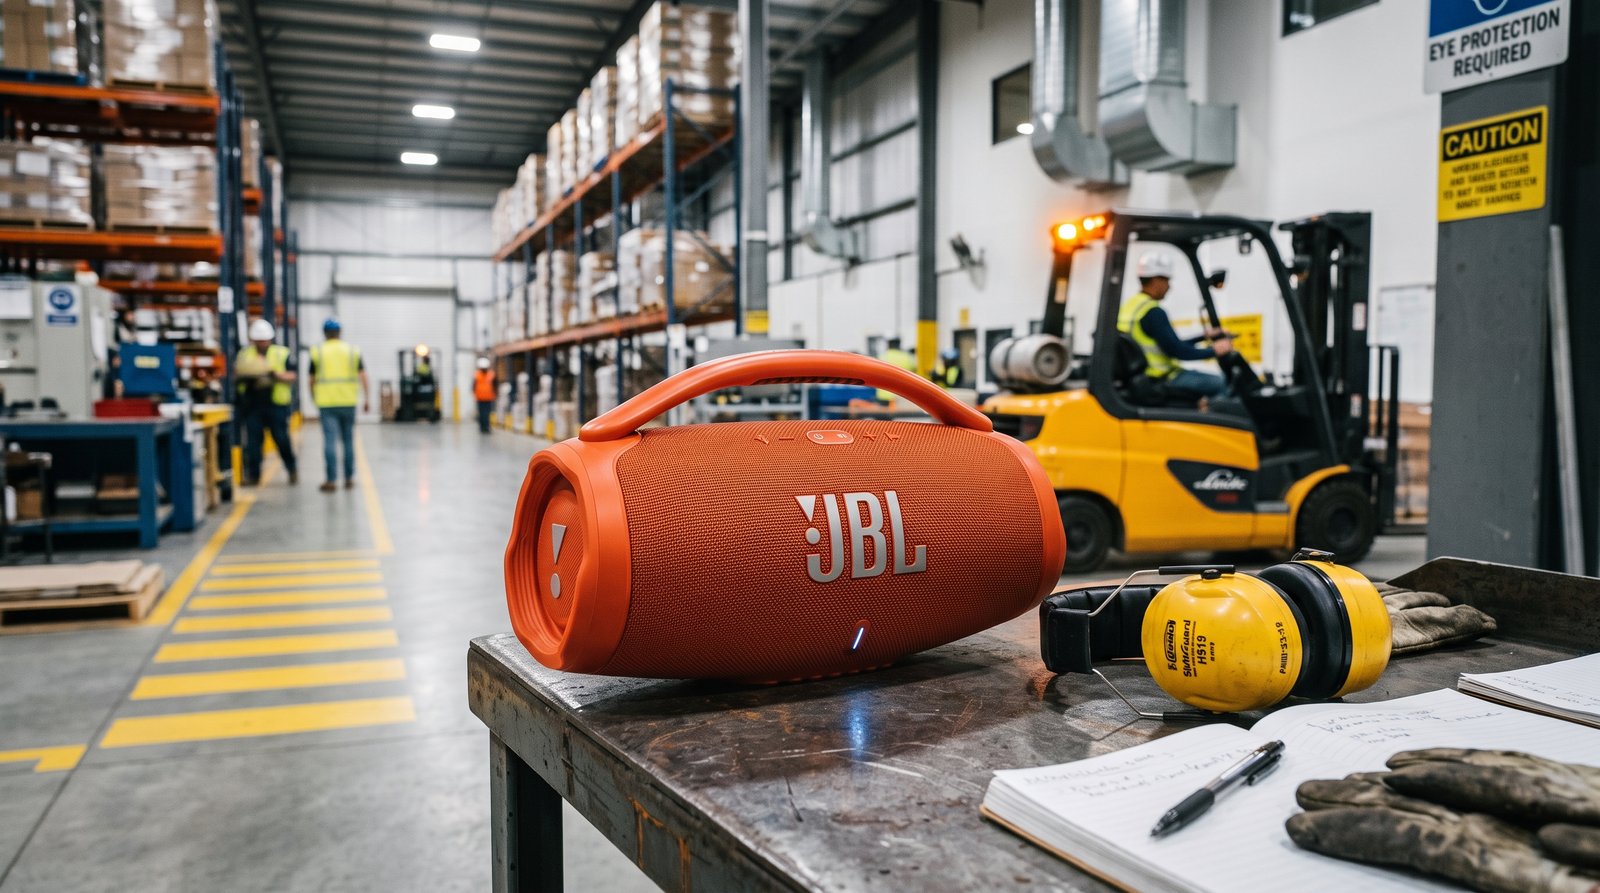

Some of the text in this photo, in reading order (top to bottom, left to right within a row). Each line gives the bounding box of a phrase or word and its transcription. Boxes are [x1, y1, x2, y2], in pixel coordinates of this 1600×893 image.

[1430, 7, 1560, 62] EYE PROTECTION
[1453, 41, 1531, 77] REQUIRED
[1445, 117, 1539, 158] CAUTION
[796, 490, 927, 583] JBL
[1196, 635, 1207, 665] HS19
